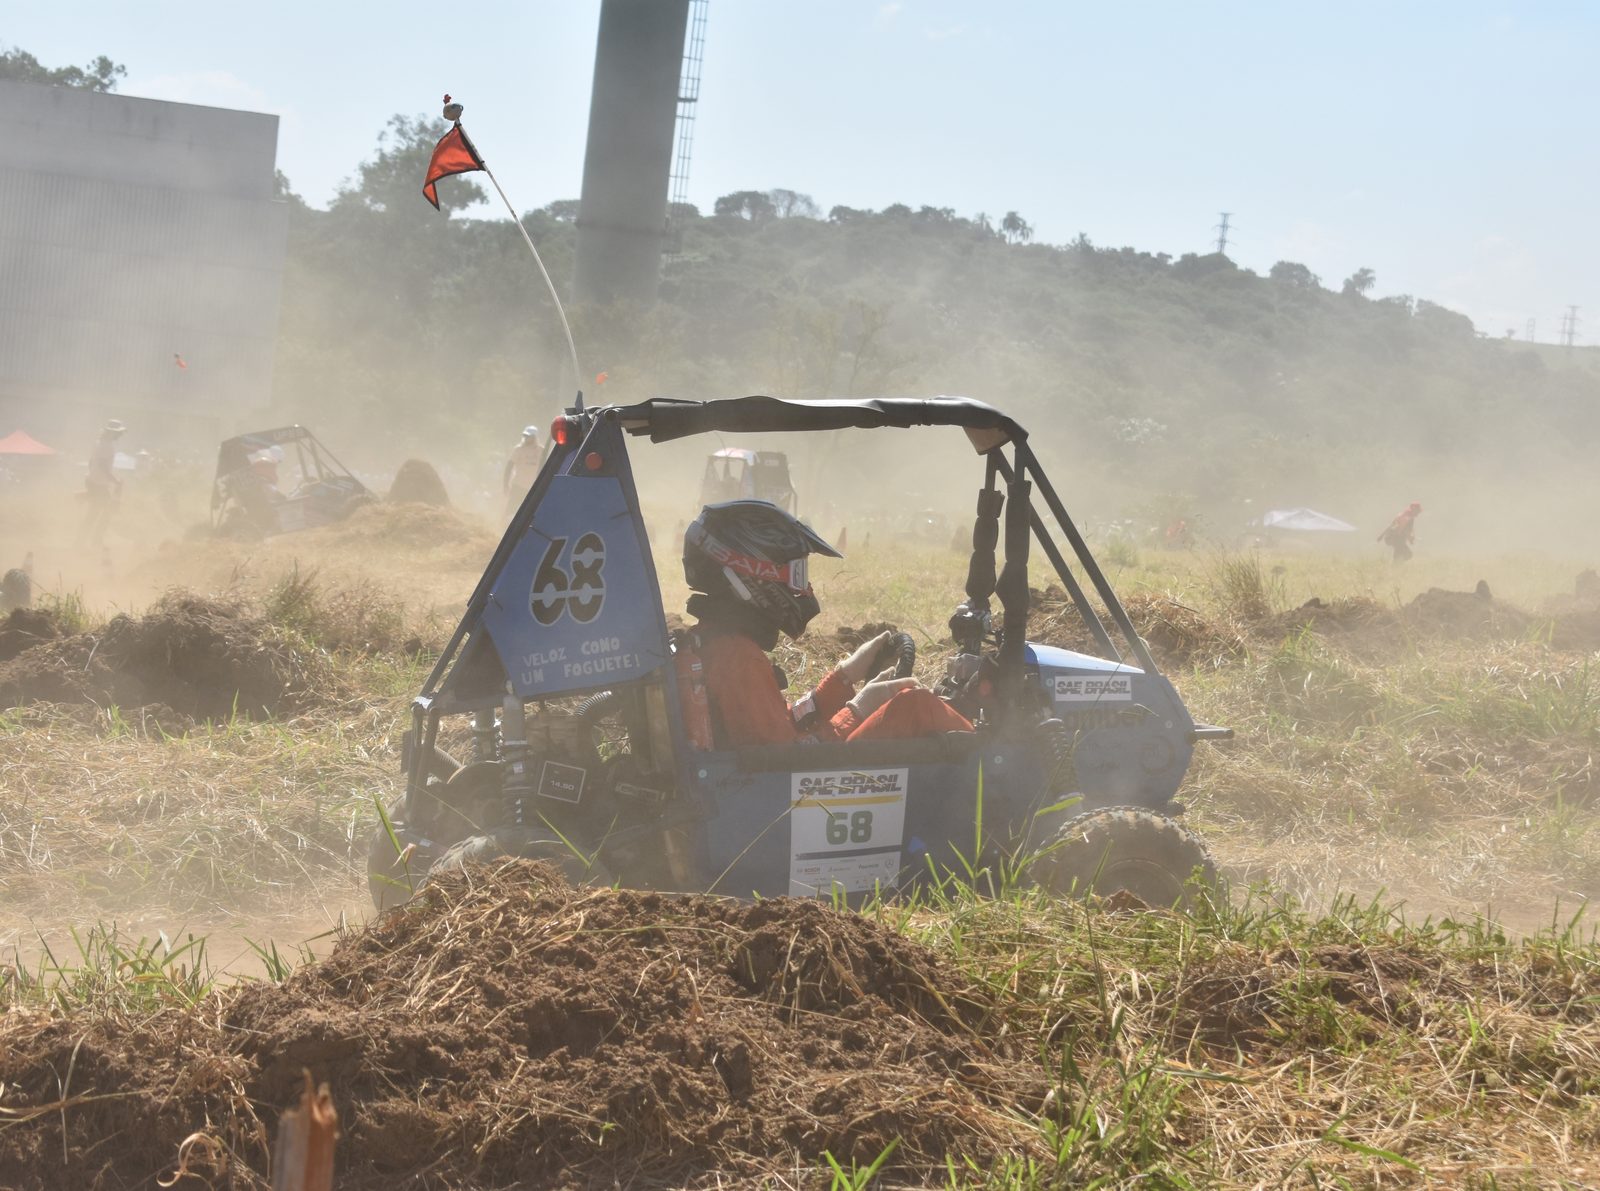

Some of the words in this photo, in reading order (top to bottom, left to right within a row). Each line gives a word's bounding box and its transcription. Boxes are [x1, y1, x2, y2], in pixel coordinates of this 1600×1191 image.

[529, 531, 606, 627] 68
[523, 648, 567, 667] VELOZ
[521, 669, 544, 685] UM
[1056, 681, 1082, 695] SAE
[1085, 681, 1130, 694] BRASIL
[798, 776, 835, 795] SAE
[838, 774, 902, 795] BRASIL
[826, 810, 873, 845] 68
